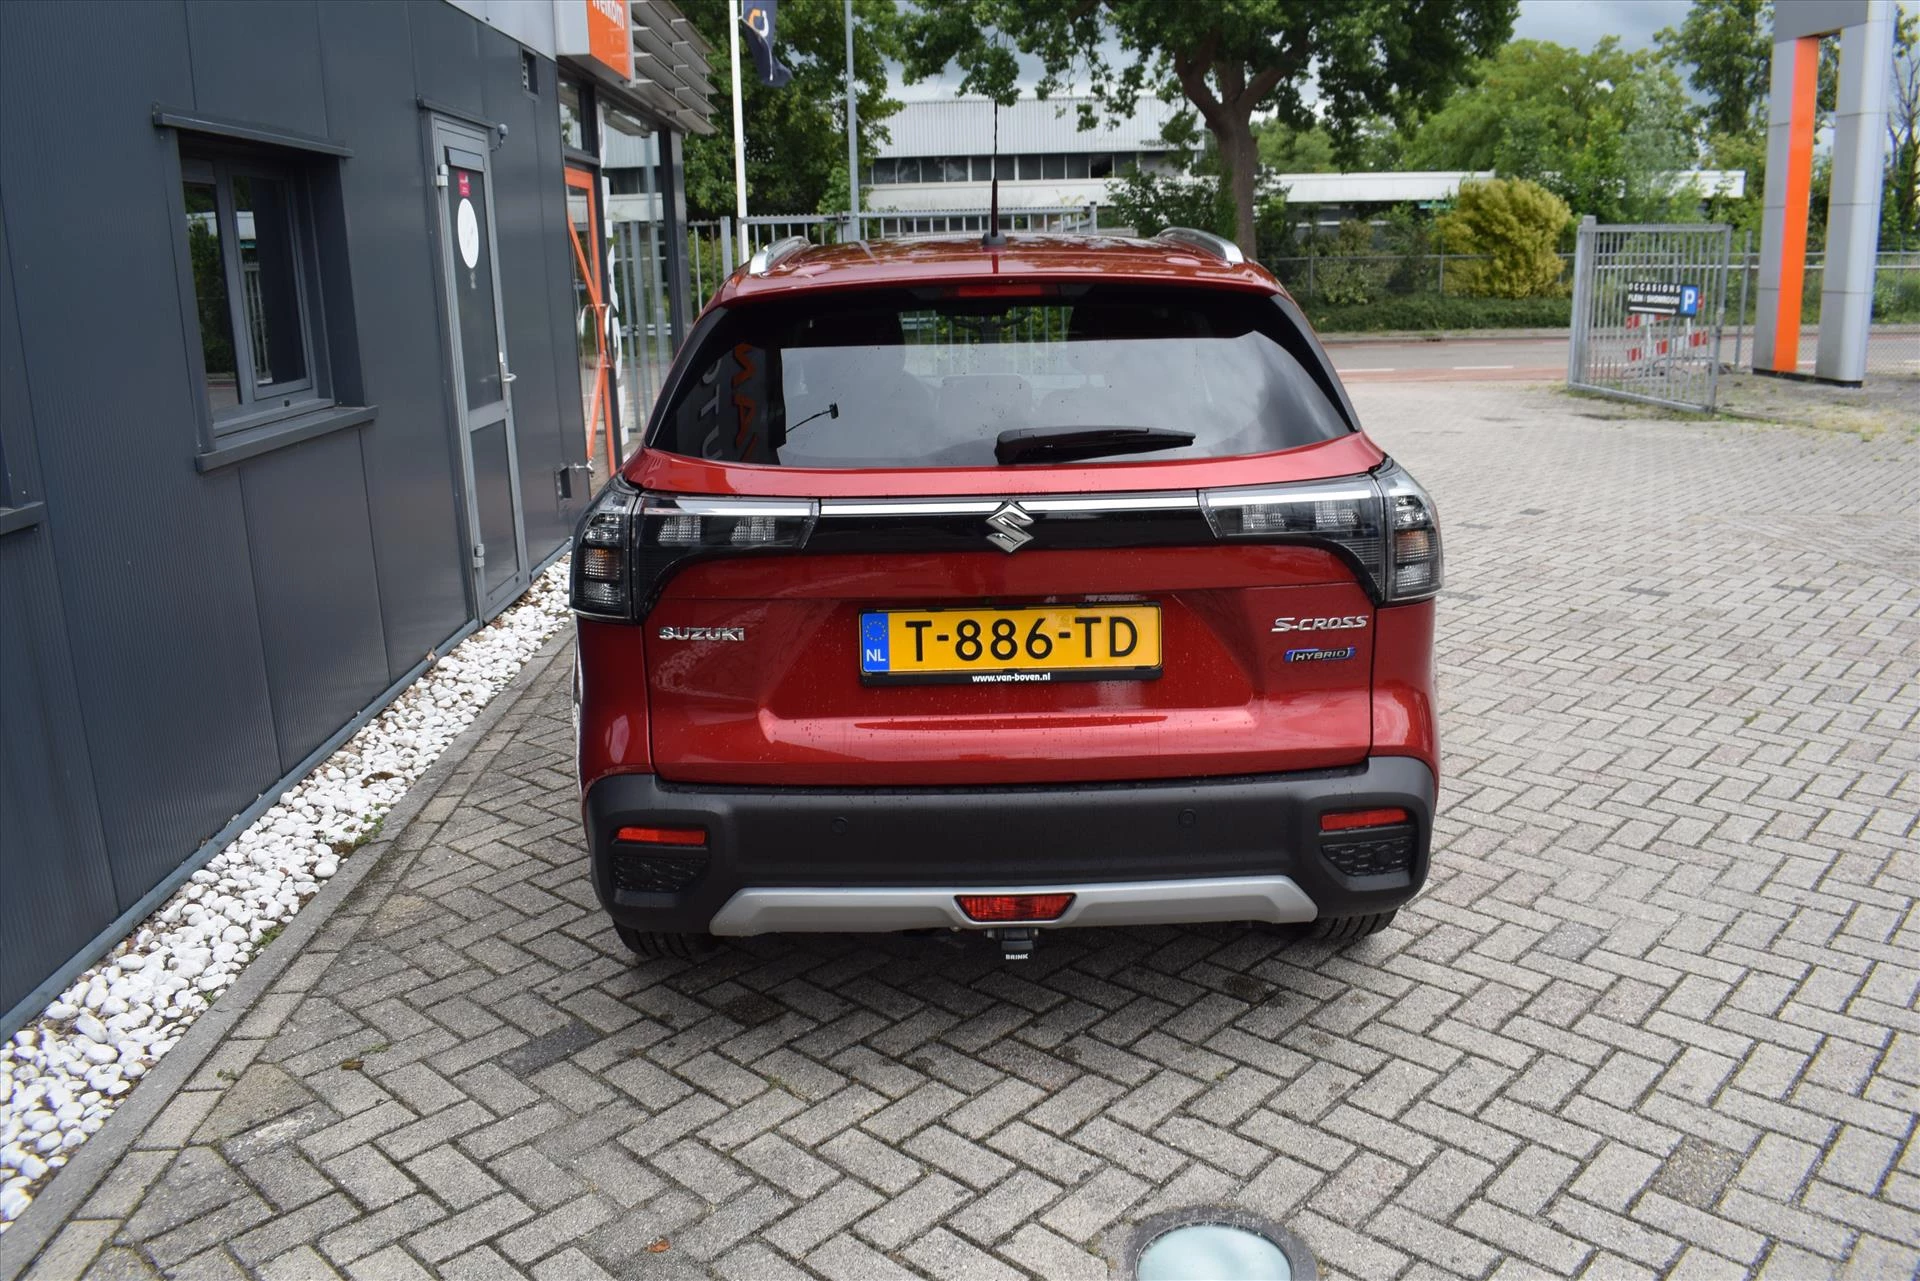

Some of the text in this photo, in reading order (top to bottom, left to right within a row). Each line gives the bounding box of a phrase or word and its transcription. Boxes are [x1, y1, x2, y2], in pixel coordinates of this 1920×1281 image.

[1628, 282, 1681, 293] OCCASIONS
[1683, 289, 1696, 311] P
[1271, 615, 1369, 632] S-CROSS
[659, 626, 745, 641] SUZUKI
[905, 615, 1138, 662] T-886-TD
[866, 649, 886, 662] NL
[1295, 650, 1346, 661] HYBRID
[972, 672, 1051, 683] www.van-boven.nl
